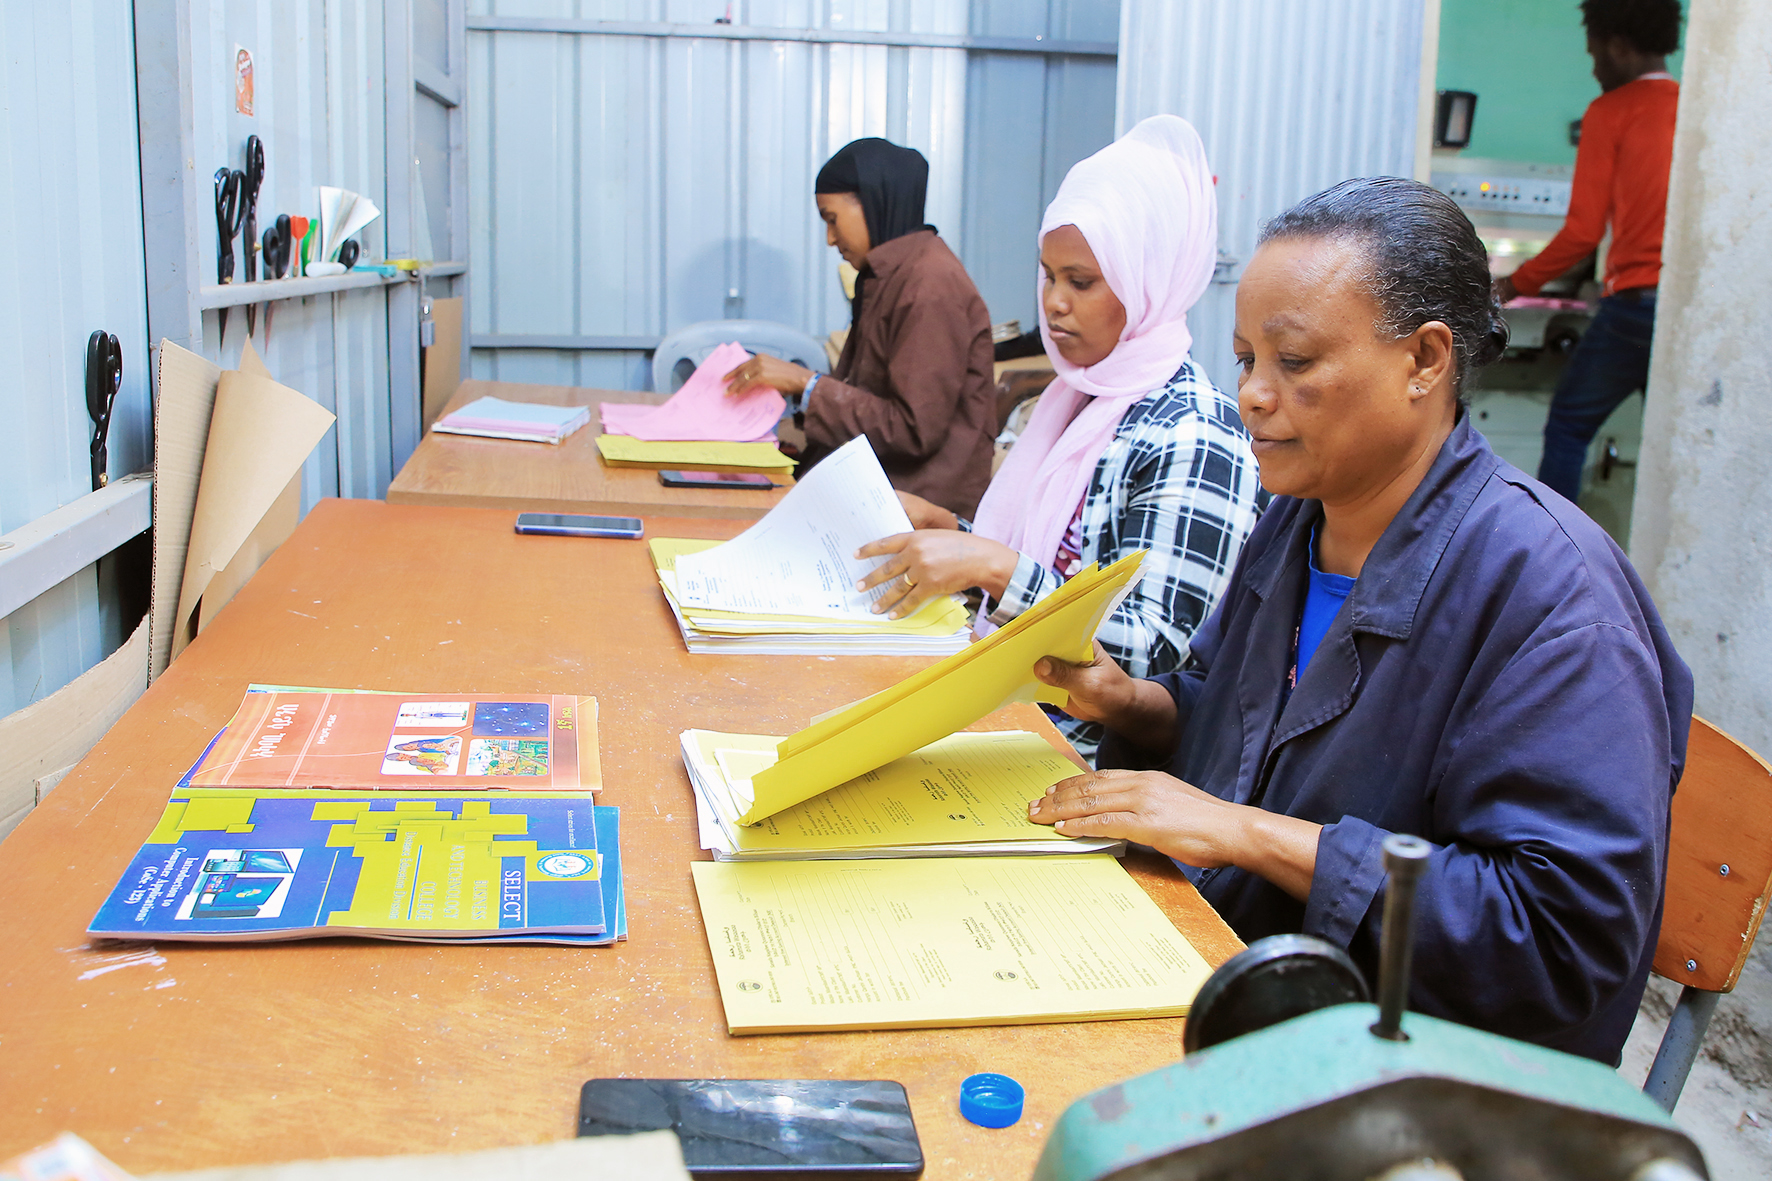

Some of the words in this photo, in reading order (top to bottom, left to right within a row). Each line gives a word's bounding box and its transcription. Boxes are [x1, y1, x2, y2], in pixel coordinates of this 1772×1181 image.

[401, 831, 418, 856] Distance
[450, 845, 465, 861] AND
[160, 847, 187, 878] Computer
[166, 857, 199, 898] Introduction
[394, 857, 413, 889] Education
[124, 889, 146, 904] 123)
[135, 879, 169, 922] Applications
[161, 898, 174, 907] to
[388, 890, 406, 920] Division
[415, 881, 437, 921] COLLEGE
[443, 861, 464, 919] TECHNOLOGY
[471, 880, 489, 920] BUSINESS
[503, 870, 522, 921] SELECT
